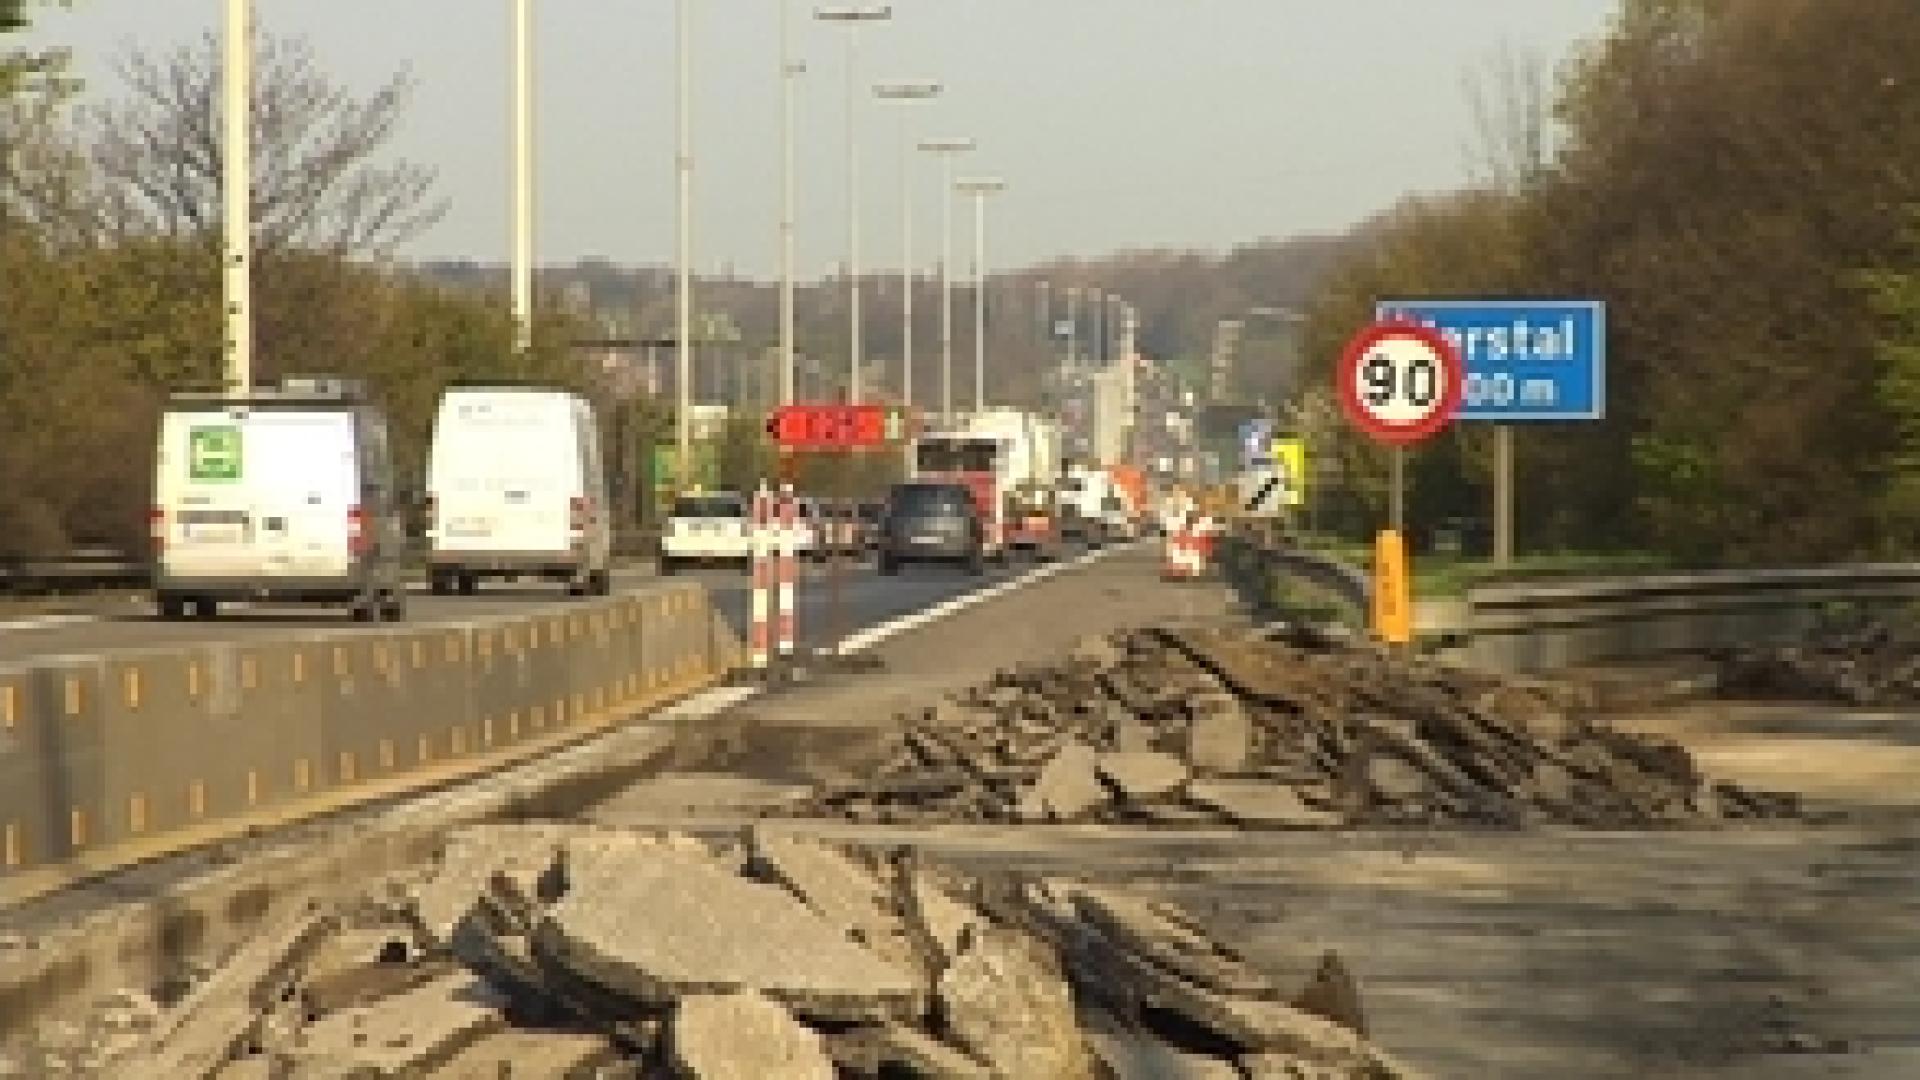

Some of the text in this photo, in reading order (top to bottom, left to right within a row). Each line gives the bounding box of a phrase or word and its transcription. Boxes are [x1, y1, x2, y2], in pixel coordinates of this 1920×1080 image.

[1397, 315, 1574, 360] rstal
[1362, 355, 1436, 406] 90
[1520, 378, 1558, 406] m
